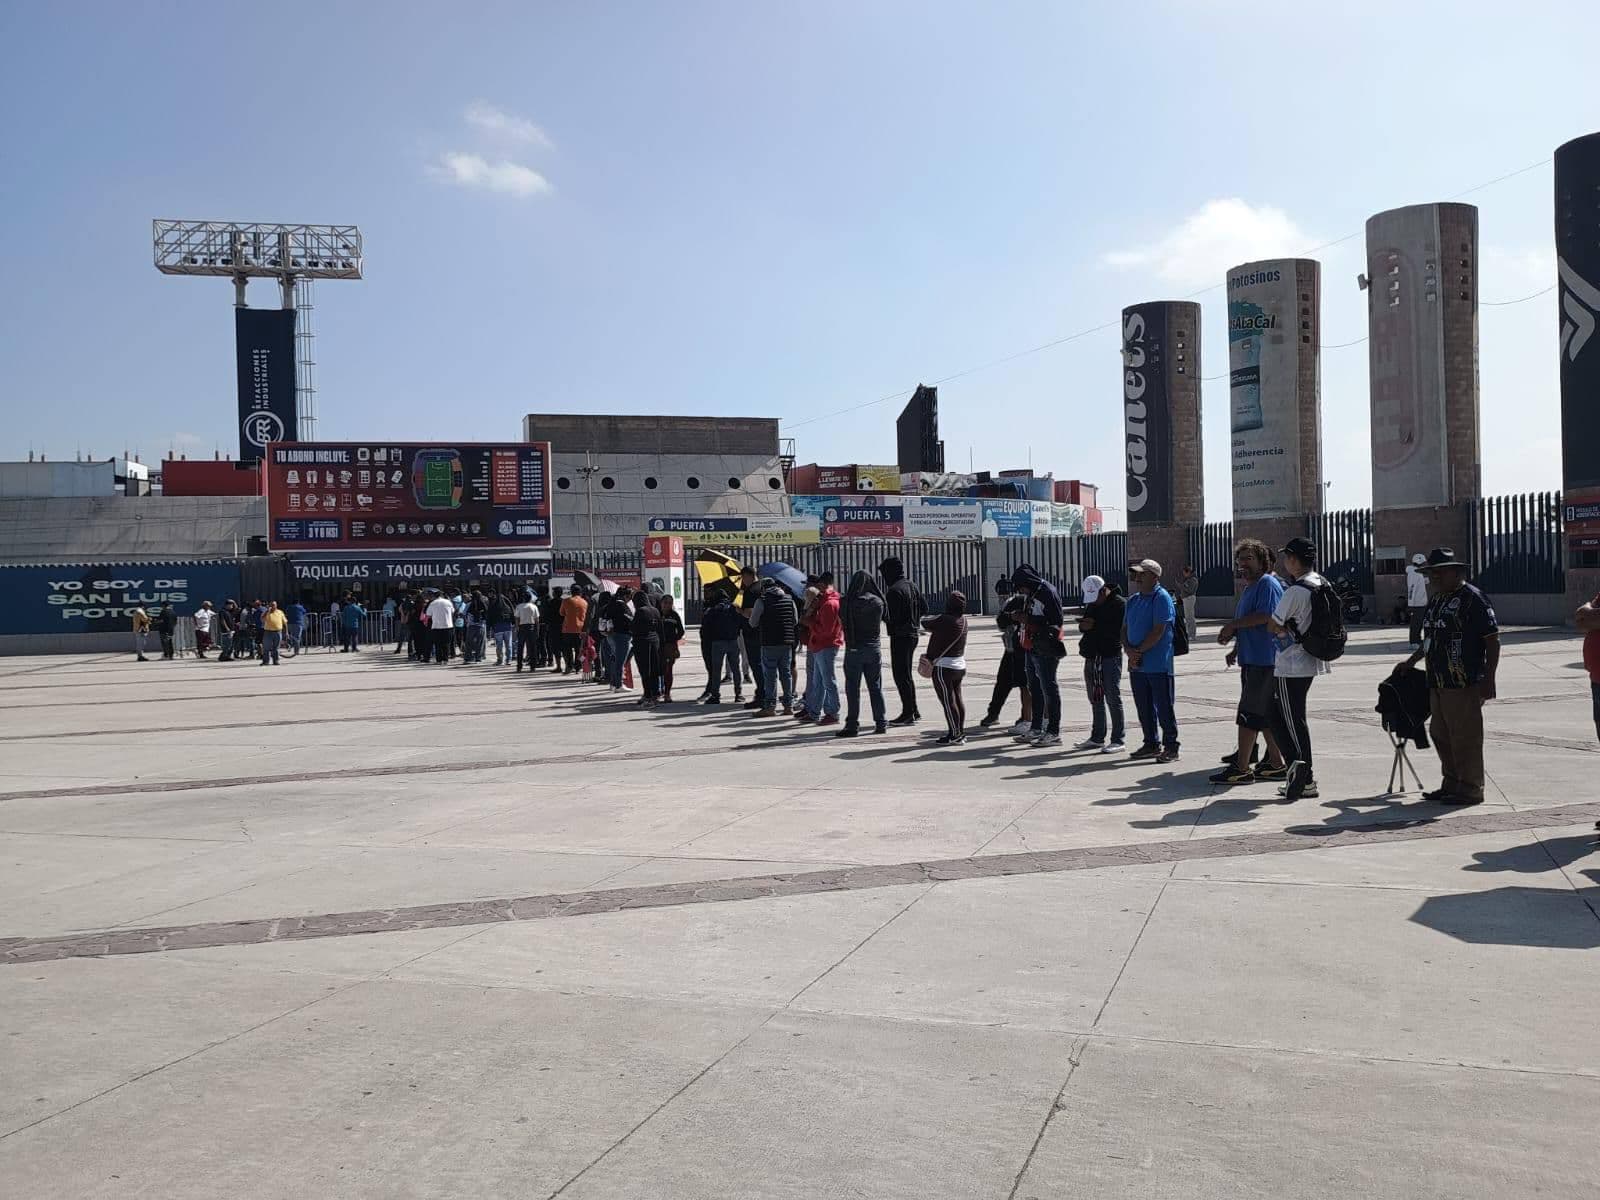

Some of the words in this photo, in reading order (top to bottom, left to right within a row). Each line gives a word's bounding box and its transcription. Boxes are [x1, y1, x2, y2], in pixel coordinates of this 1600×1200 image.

[253, 349, 261, 409] REFACCIONES
[261, 349, 270, 409] INDUSTRIALES
[1123, 312, 1148, 512] Canels
[276, 450, 286, 462] TU
[288, 450, 315, 463] ABONO
[1003, 501, 1031, 515] EQUIPO
[843, 510, 881, 521] PUERTA
[884, 510, 891, 520] 5
[670, 520, 706, 531] PUERTA
[709, 520, 715, 530] 5
[294, 564, 369, 580] TAQUILLAS
[386, 562, 461, 578] TAQUILLAS
[477, 561, 550, 577] TAQUILLAS
[48, 580, 83, 591] YO
[92, 579, 145, 590] SOY
[154, 579, 188, 588] DE
[47, 592, 112, 605] SAN
[122, 591, 188, 603] LUIS
[62, 606, 164, 619] POTOS
